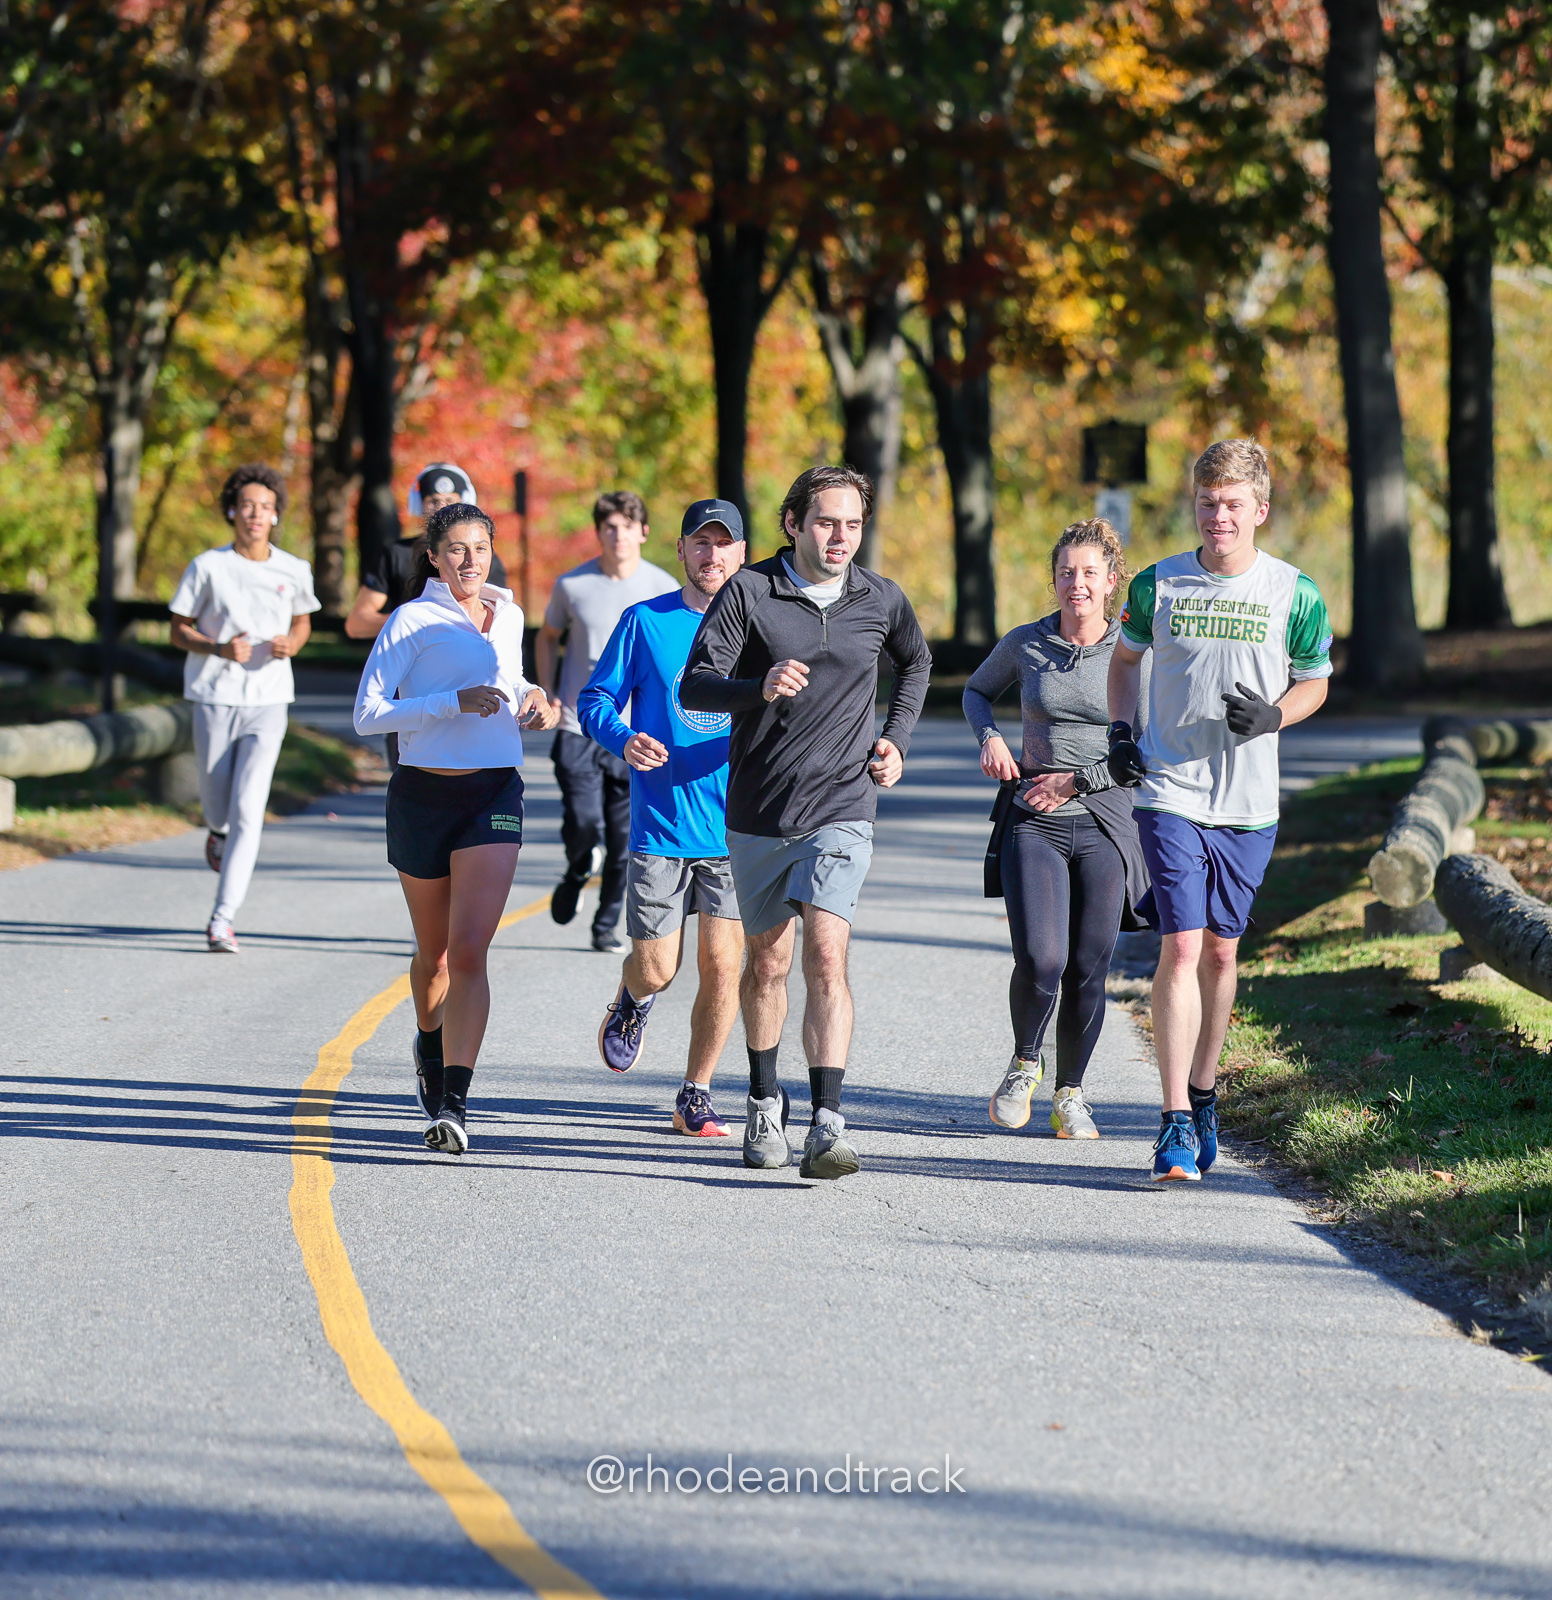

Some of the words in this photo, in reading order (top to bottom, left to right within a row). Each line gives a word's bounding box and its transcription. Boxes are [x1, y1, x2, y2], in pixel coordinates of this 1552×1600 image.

[1172, 598, 1211, 611] ADULT
[1213, 599, 1271, 618] SENTINEL
[1170, 614, 1268, 643] STRIDERS
